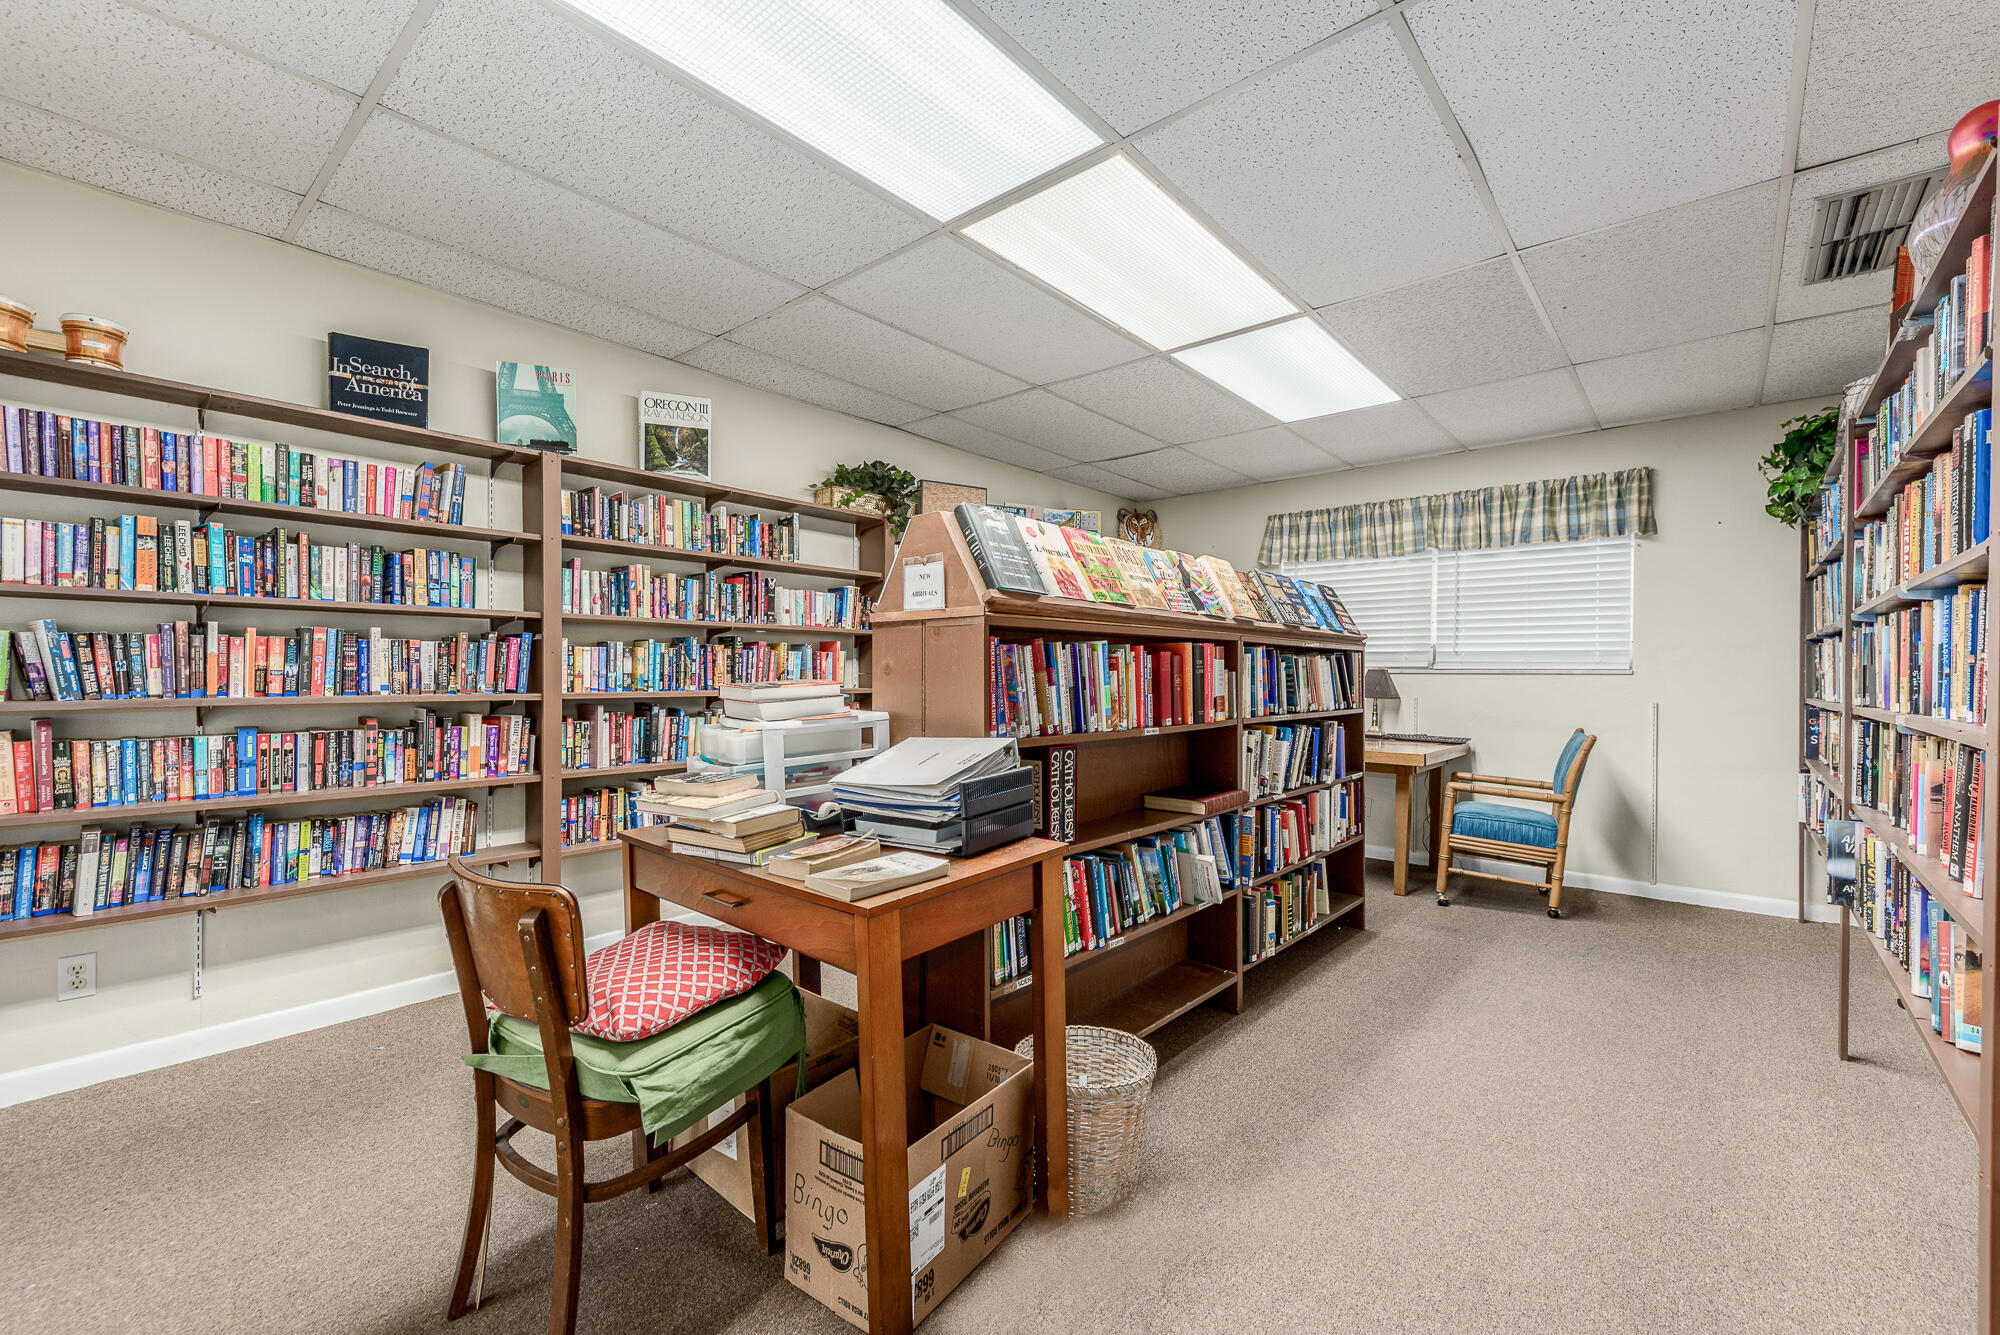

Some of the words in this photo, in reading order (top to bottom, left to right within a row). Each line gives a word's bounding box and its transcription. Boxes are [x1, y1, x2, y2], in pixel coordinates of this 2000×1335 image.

[350, 356, 411, 380] Search
[536, 370, 571, 384] PARIS
[345, 377, 423, 402] America
[337, 400, 351, 408] Peter
[644, 397, 696, 414] OREGON
[699, 404, 708, 414] III
[644, 408, 663, 419] RAY
[164, 535, 172, 546] LEE
[178, 526, 186, 536] LEE
[164, 547, 172, 566] CHILD
[912, 590, 938, 598] ARRIVALS
[1064, 750, 1074, 842] CATHOLICISM
[1952, 801, 1962, 861] ANATHEM
[1965, 842, 1975, 880] RESOLVE
[986, 1128, 1019, 1162] Bingo
[794, 1173, 849, 1231] Bingo
[821, 1243, 849, 1265] Charmin
